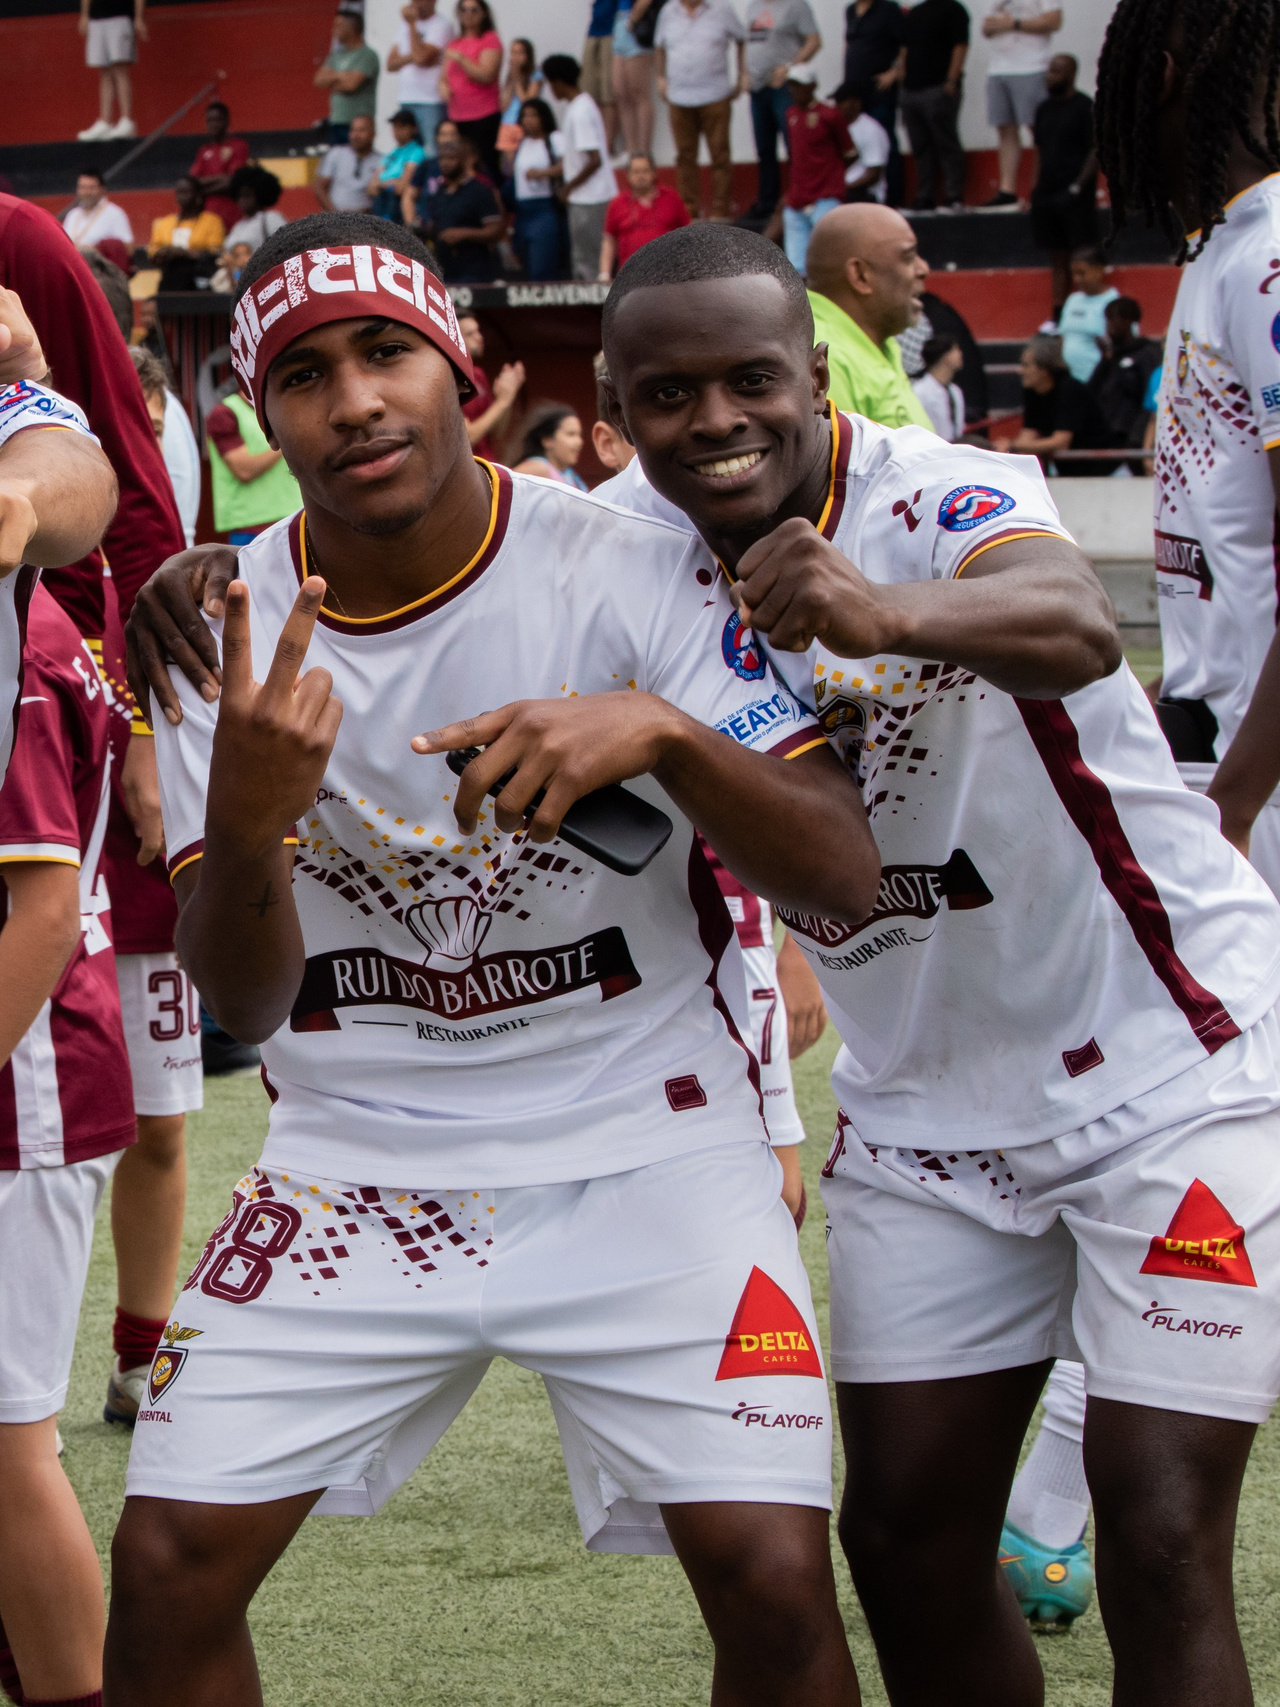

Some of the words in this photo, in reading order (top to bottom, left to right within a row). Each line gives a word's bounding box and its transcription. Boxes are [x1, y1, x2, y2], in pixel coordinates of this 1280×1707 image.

[940, 485, 976, 512] MARVILA
[815, 927, 910, 970] RESTAURANTE
[332, 957, 392, 999] RUI
[392, 965, 435, 1007] DO
[439, 942, 598, 1014] BARROTE
[415, 1018, 530, 1042] RESTAURANTE
[1165, 1238, 1237, 1259] DELTA
[1183, 1258, 1220, 1269] CAFÉS
[1151, 1315, 1243, 1339] PLAYOFF
[739, 1331, 810, 1352] DELTA
[763, 1354, 798, 1362] CAFÉS
[745, 1413, 824, 1430] PLAYOFF
